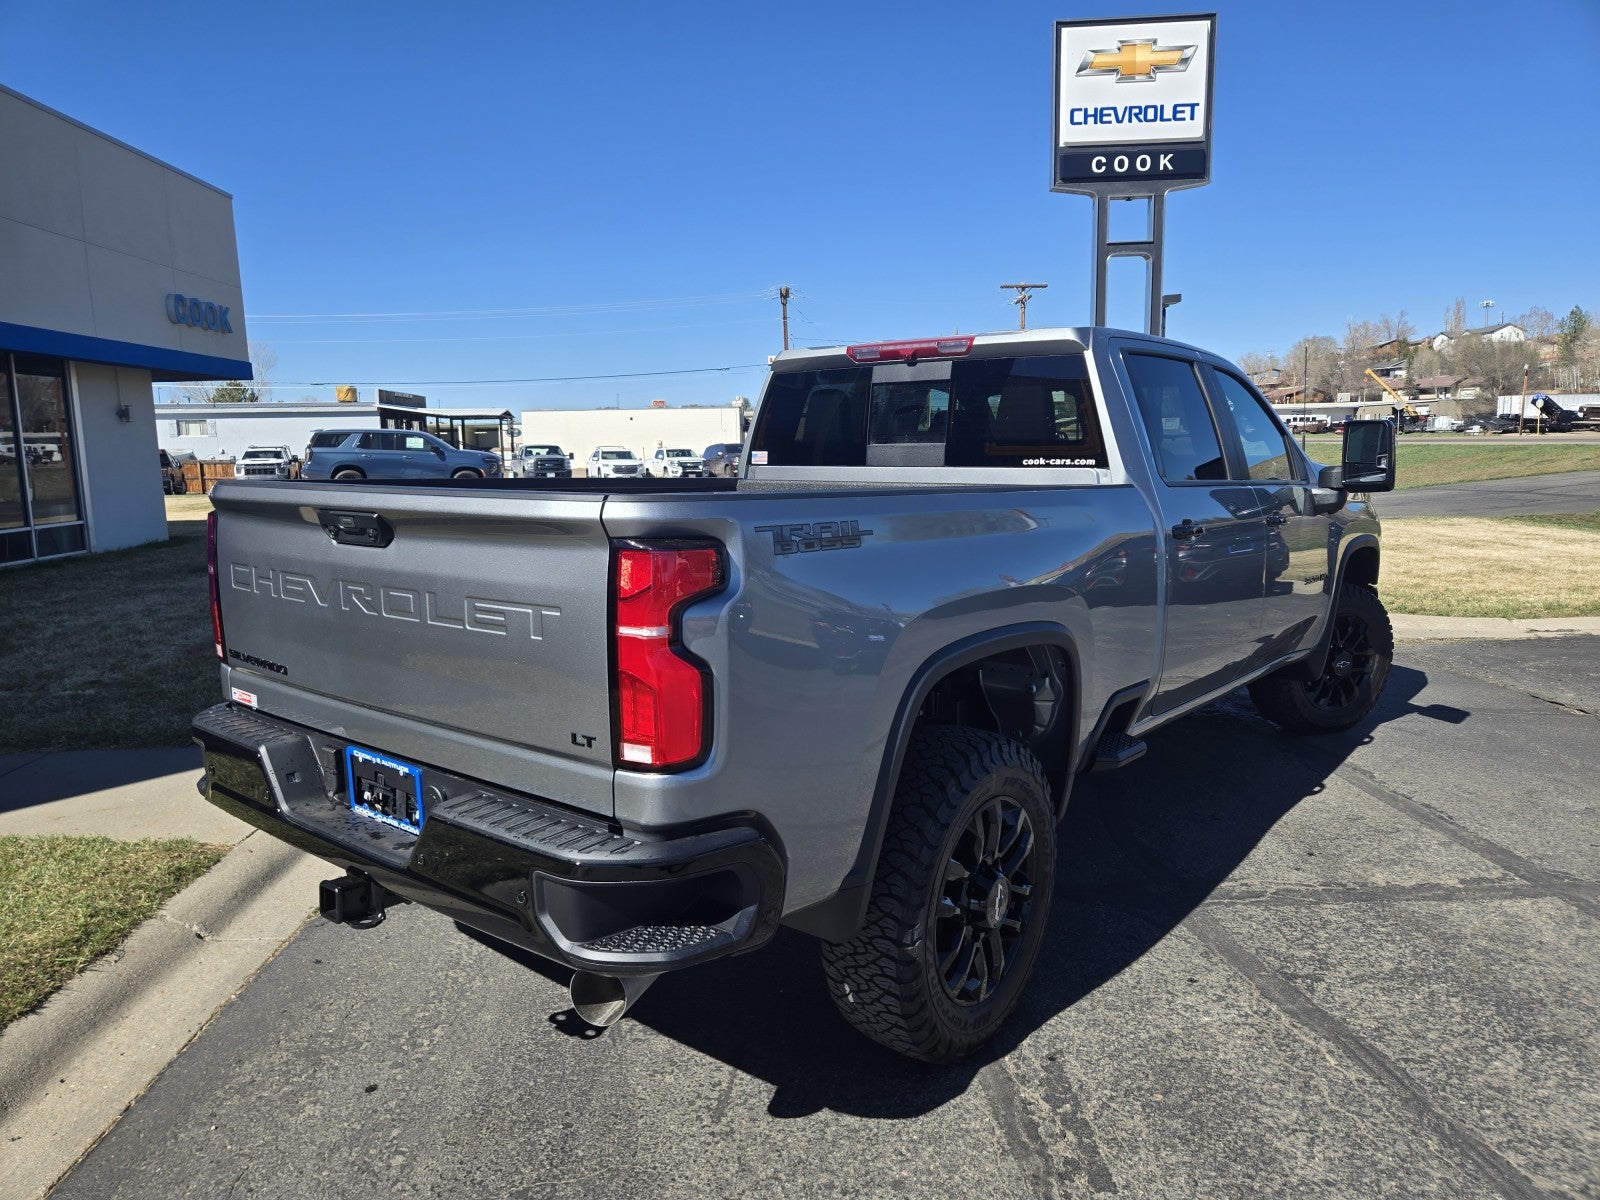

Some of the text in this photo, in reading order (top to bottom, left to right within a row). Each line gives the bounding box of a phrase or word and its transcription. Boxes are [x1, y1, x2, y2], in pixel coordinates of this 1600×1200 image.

[1069, 102, 1200, 126] CHEVROLET
[1091, 153, 1174, 174] COOK
[168, 293, 234, 334] COOK
[1022, 457, 1096, 466] cook-cars.com
[754, 520, 874, 541] TRAIL
[773, 538, 862, 556] BOSS
[230, 562, 562, 641] CHEVROLET
[571, 732, 597, 749] LT
